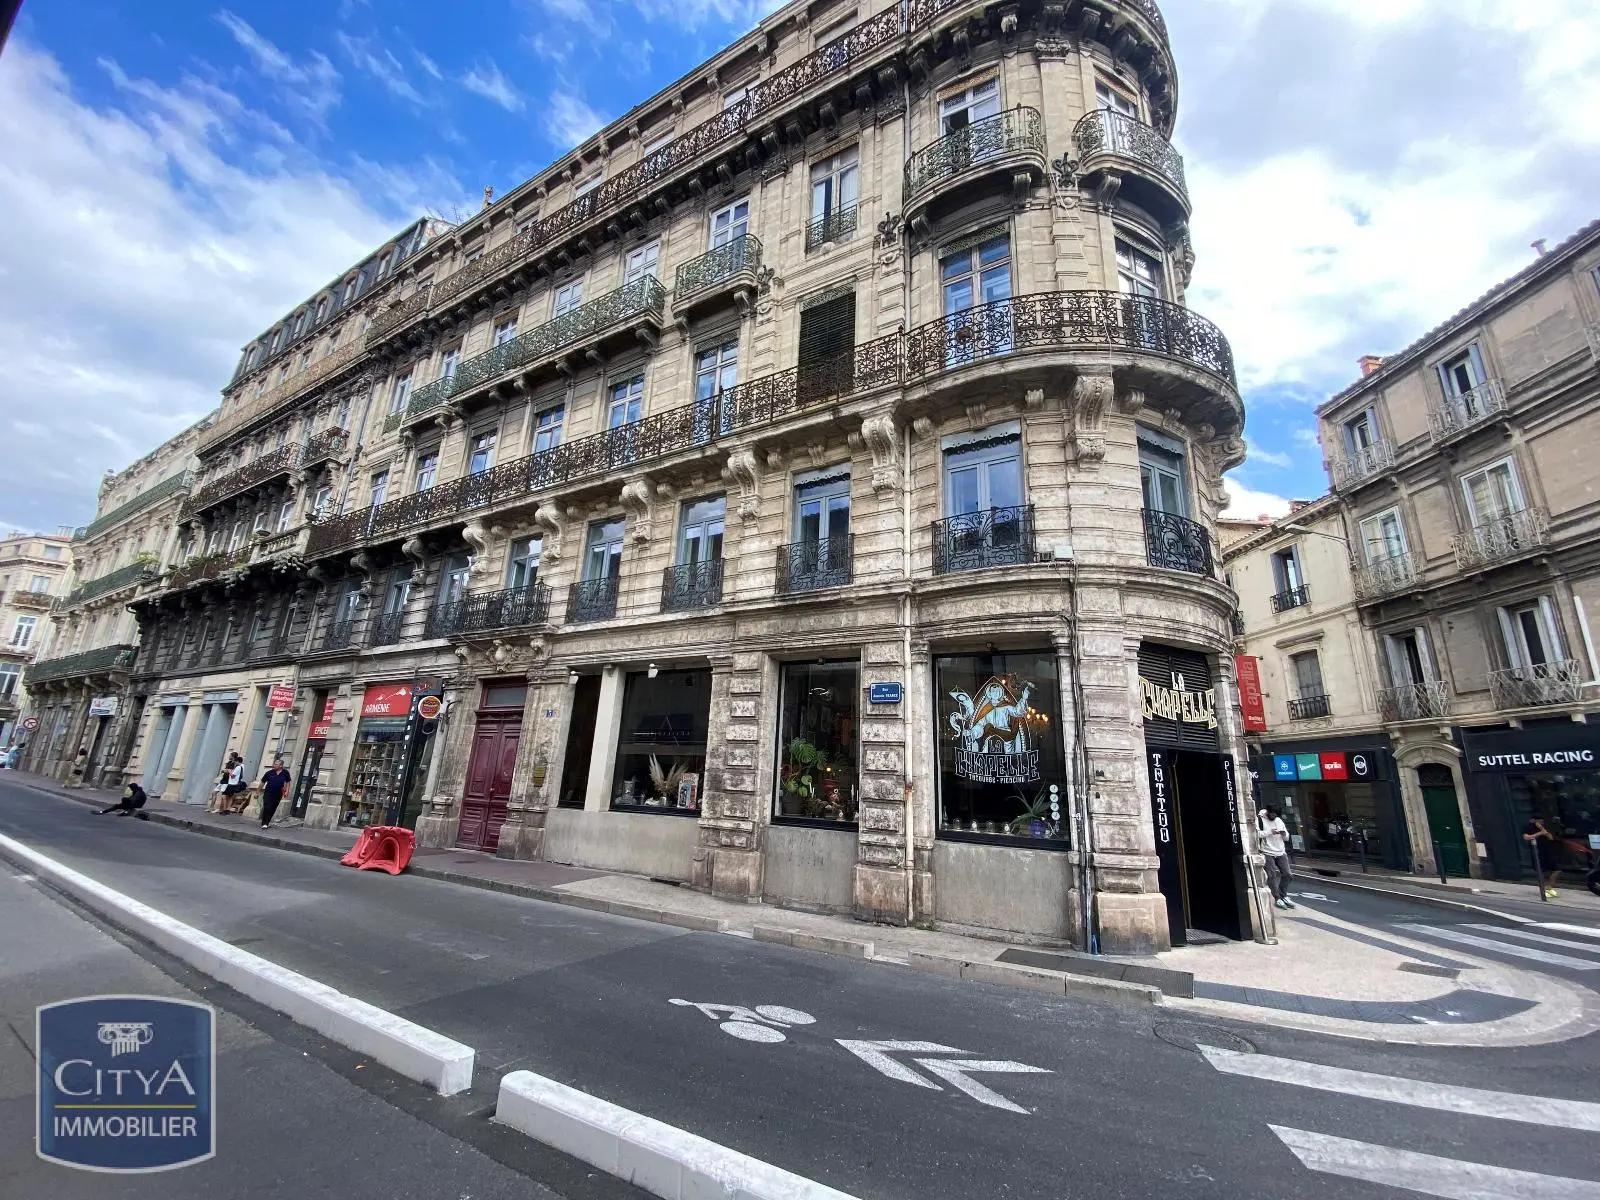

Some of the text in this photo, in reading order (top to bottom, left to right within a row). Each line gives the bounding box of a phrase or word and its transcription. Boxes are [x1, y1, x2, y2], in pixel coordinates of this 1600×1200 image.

[1171, 671, 1186, 692] LA
[1242, 661, 1260, 706] aprilia
[1137, 675, 1218, 730] CHAPELLE
[954, 746, 1041, 782] CHAPELLE
[1324, 761, 1343, 771] aprilia
[1478, 750, 1594, 766] SUTTEL RACING
[1152, 753, 1171, 843] TATTOO
[1224, 760, 1239, 844] PIERCING
